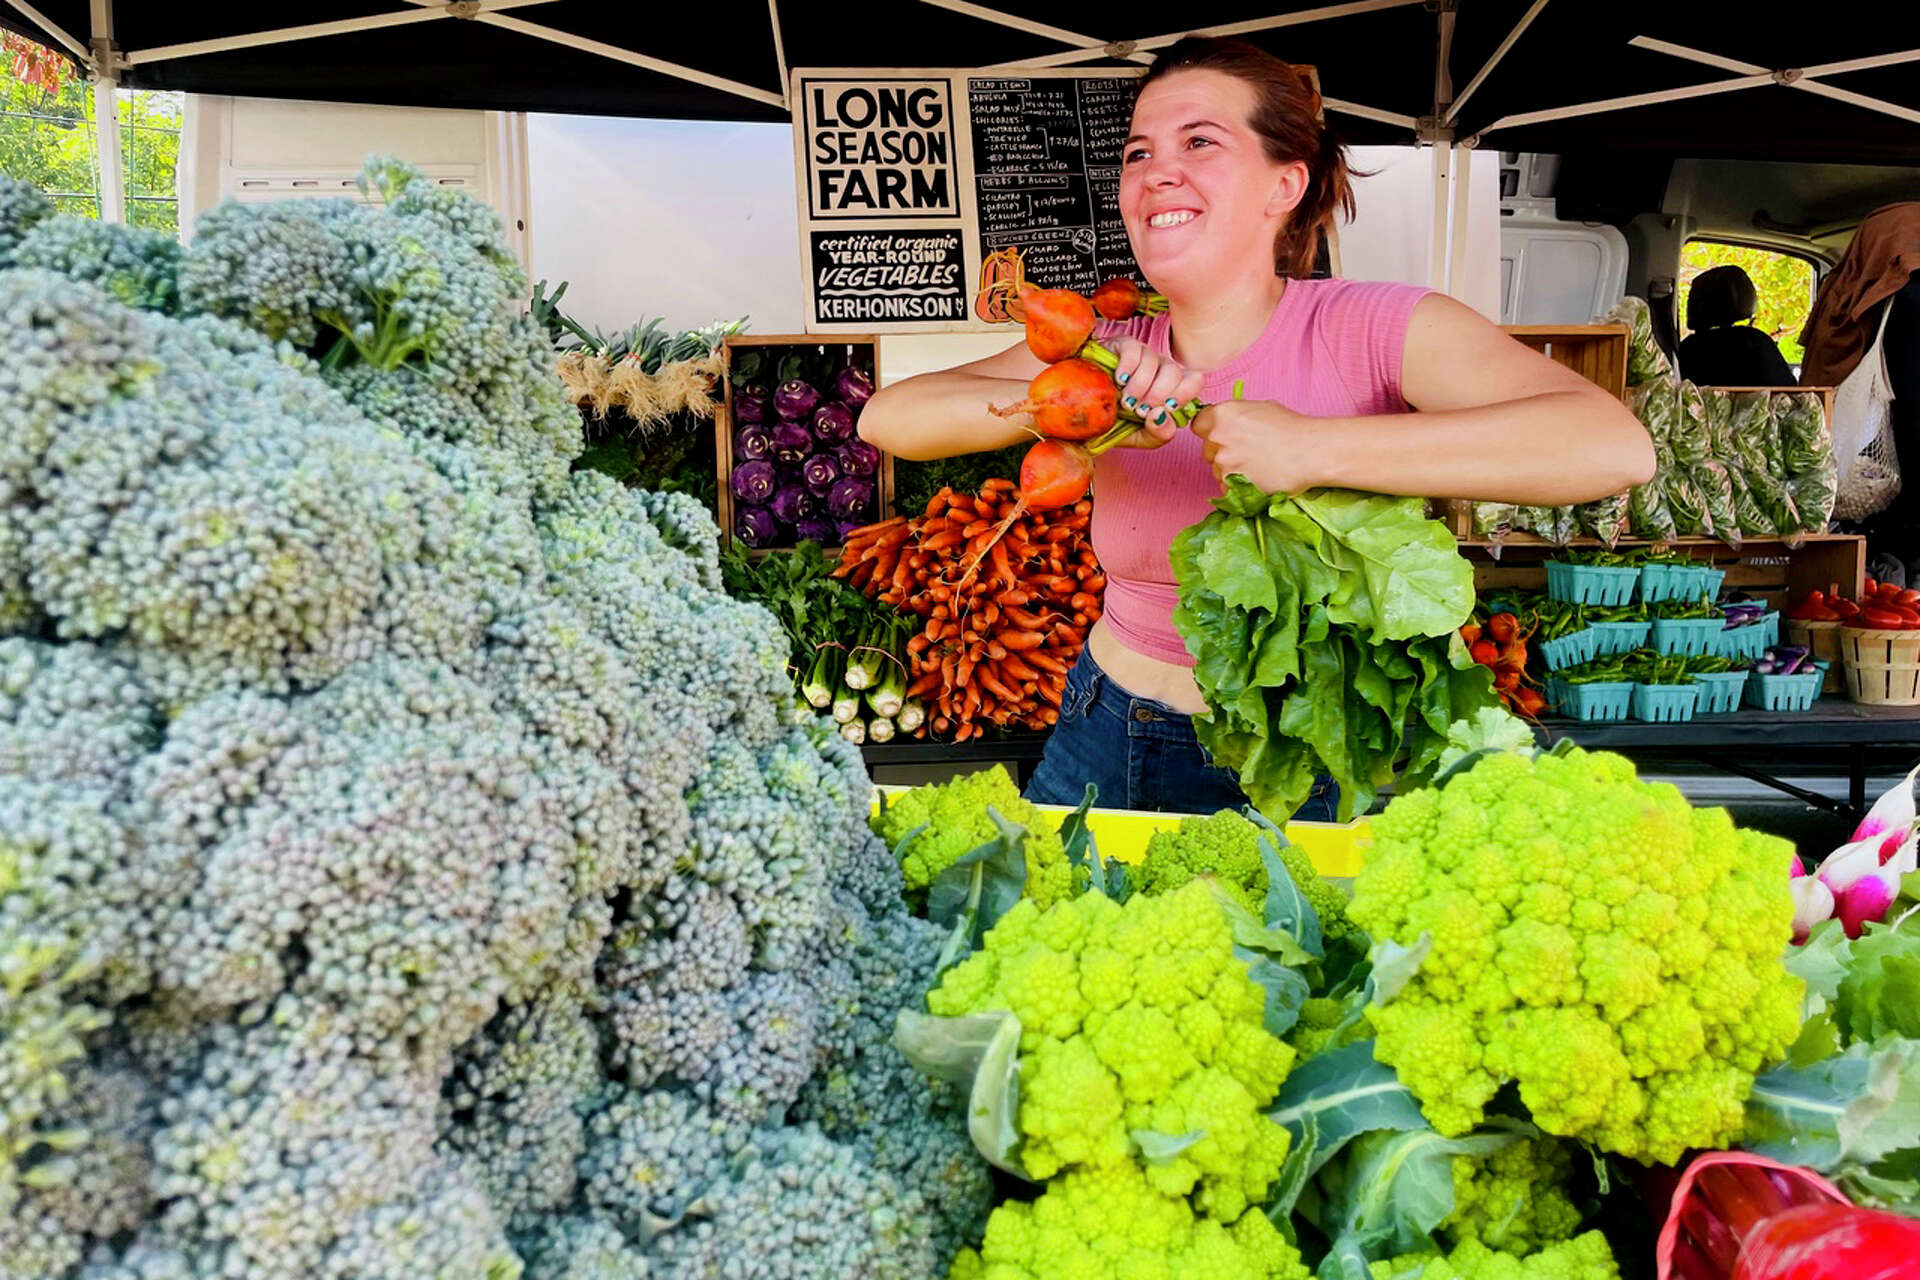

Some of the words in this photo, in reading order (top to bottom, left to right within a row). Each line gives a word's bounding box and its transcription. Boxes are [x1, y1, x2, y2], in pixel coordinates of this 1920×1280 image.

[1085, 80, 1114, 90] ROOTS
[1085, 94, 1121, 104] CARROTS
[814, 88, 943, 129] LONG
[974, 105, 1000, 113] SALAD
[1087, 104, 1118, 115] BEETS
[815, 131, 947, 165] SEASON
[983, 177, 1012, 187] HERBS
[818, 169, 950, 210] FARM
[985, 193, 1021, 202] CILANTRO
[988, 210, 1027, 221] SCALLIONS
[1031, 231, 1071, 241] GREENS
[819, 235, 893, 251] certified
[894, 234, 958, 254] organic
[1028, 244, 1060, 255] CHARD
[828, 250, 947, 264] YEAR-ROUND
[1032, 254, 1078, 264] COLLARDS
[818, 264, 959, 287] VEGETABLES
[1042, 274, 1071, 284] CURLY
[1074, 271, 1096, 280] KALE
[818, 297, 951, 318] KERHONKSON
